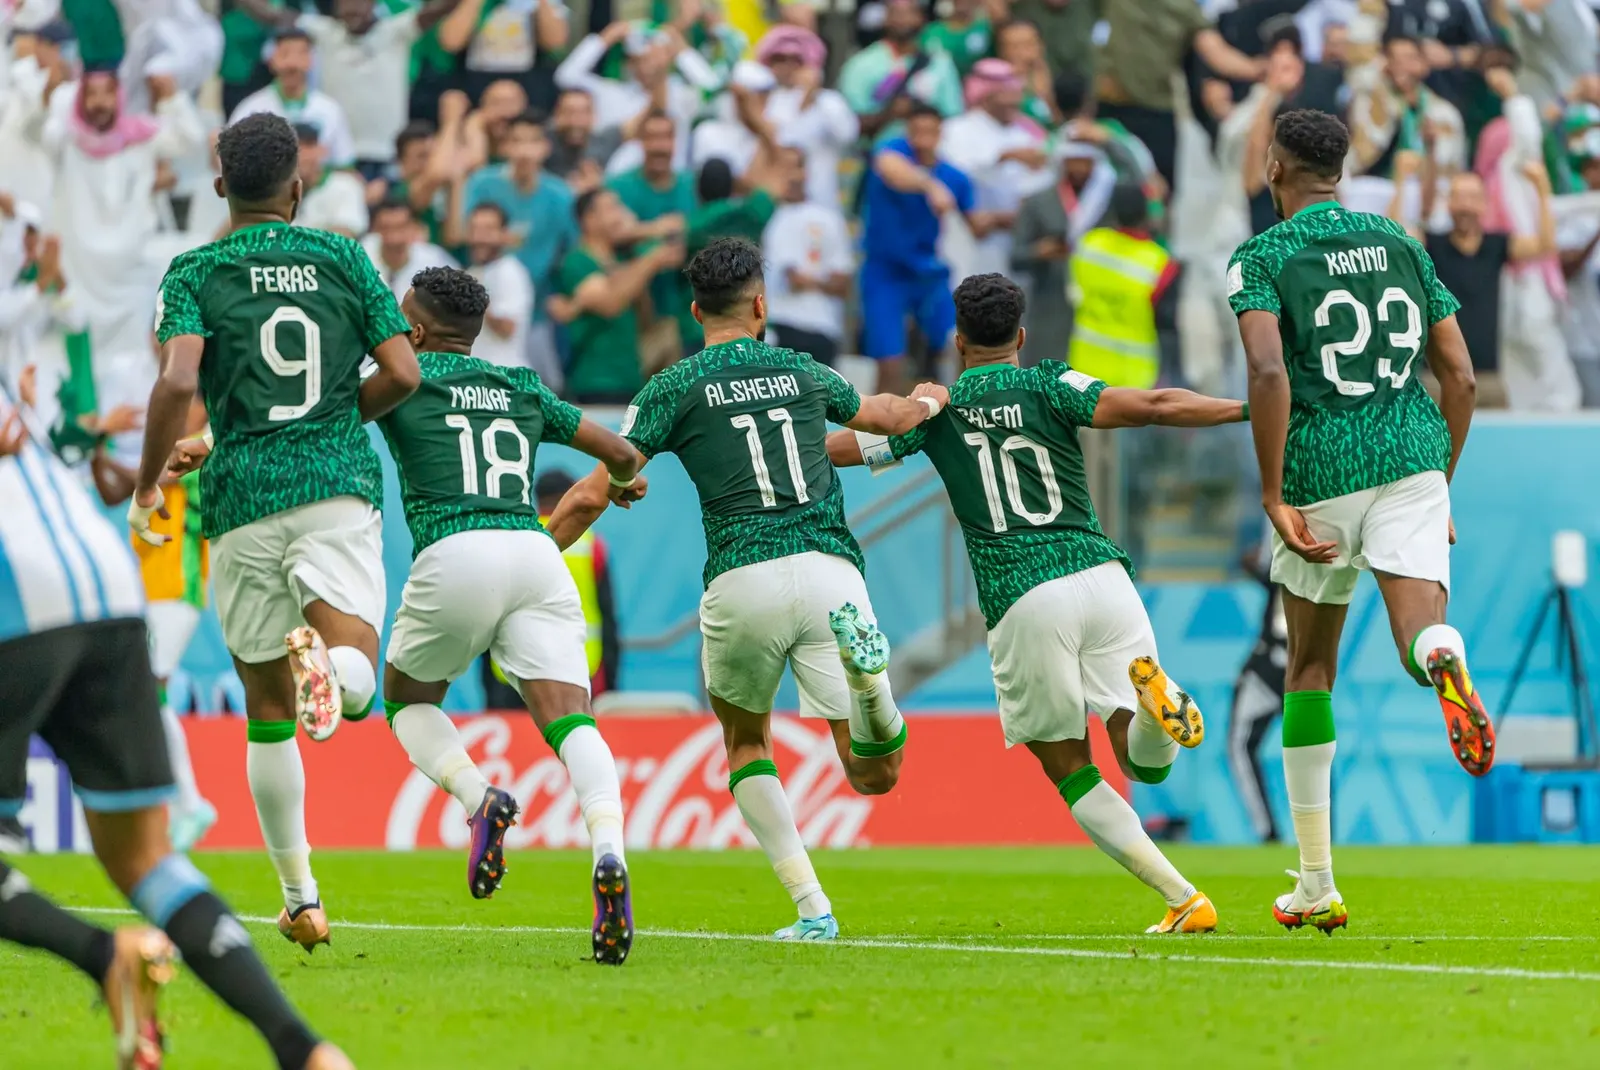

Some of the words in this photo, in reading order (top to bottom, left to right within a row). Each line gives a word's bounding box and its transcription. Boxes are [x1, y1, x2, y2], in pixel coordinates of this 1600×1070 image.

[249, 264, 319, 294] FERAS
[1323, 245, 1388, 277] KANNO
[259, 305, 321, 422] 9
[1314, 286, 1423, 397] 23
[449, 385, 512, 412] NAWAF
[704, 373, 800, 408] ALSHEHRI
[445, 414, 530, 506] 18
[730, 407, 811, 508] 11
[963, 431, 1064, 534] 10
